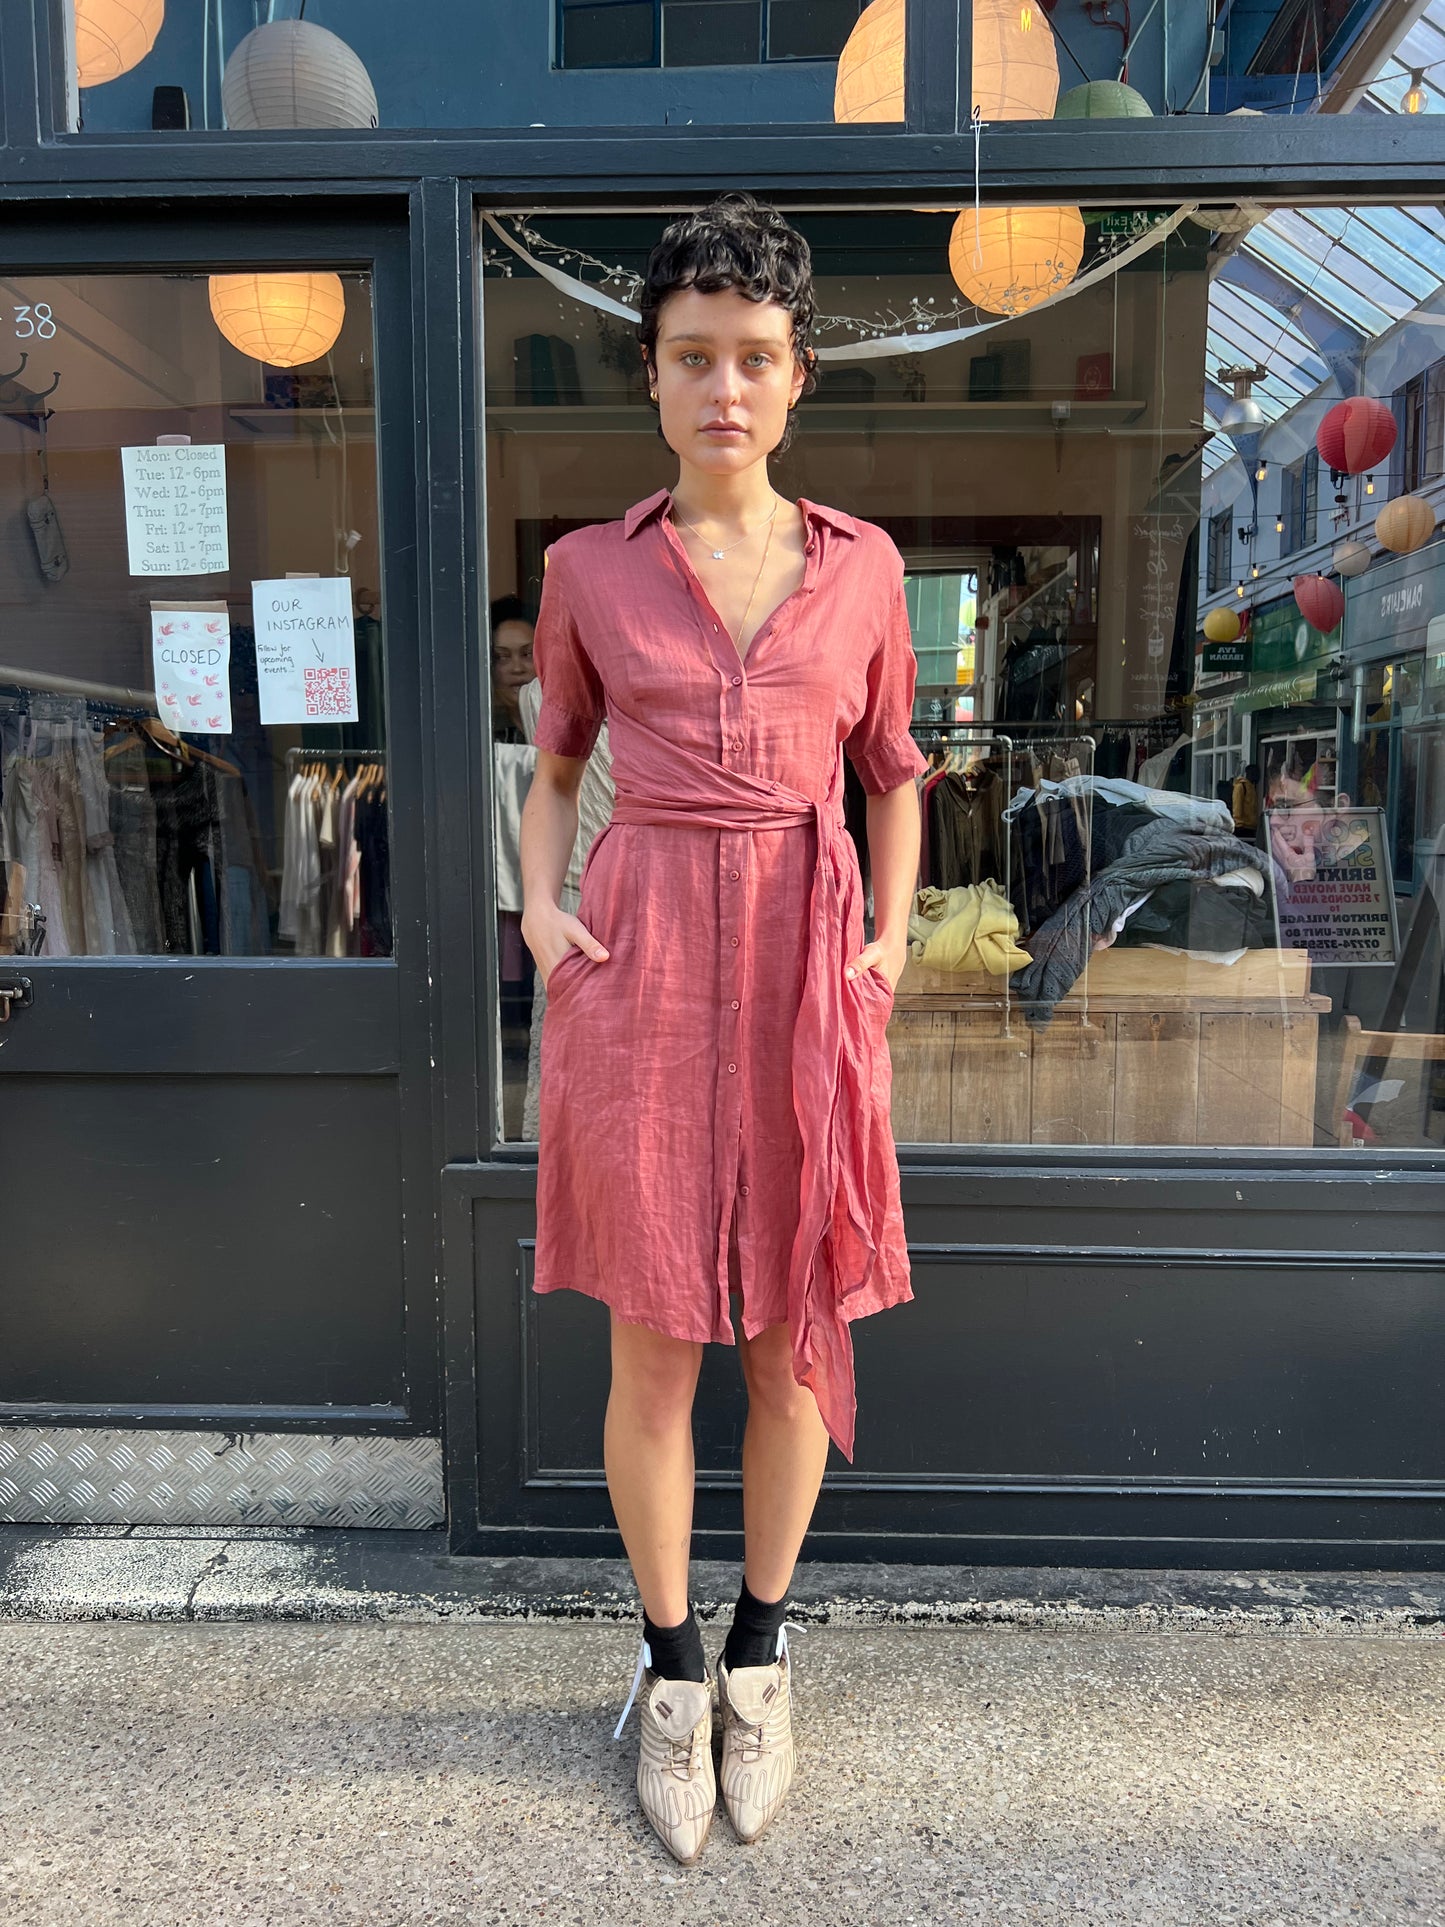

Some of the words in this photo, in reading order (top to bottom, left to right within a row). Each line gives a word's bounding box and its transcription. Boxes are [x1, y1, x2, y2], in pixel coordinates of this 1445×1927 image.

[13, 302, 57, 339] 38
[137, 449, 171, 462] Mon:
[175, 448, 217, 461] Closed
[135, 468, 165, 481] Tue:
[134, 487, 170, 499] Wed:
[132, 505, 165, 518] Thu:
[145, 523, 168, 535] Fri:
[146, 542, 170, 554] Sat:
[141, 560, 171, 572] Sun:
[272, 599, 303, 612] OUR
[267, 615, 350, 631] INSTAGRAM
[257, 644, 277, 653] Follow
[280, 643, 292, 657] for
[161, 649, 221, 665] CLOSED
[260, 656, 294, 668] upcoming
